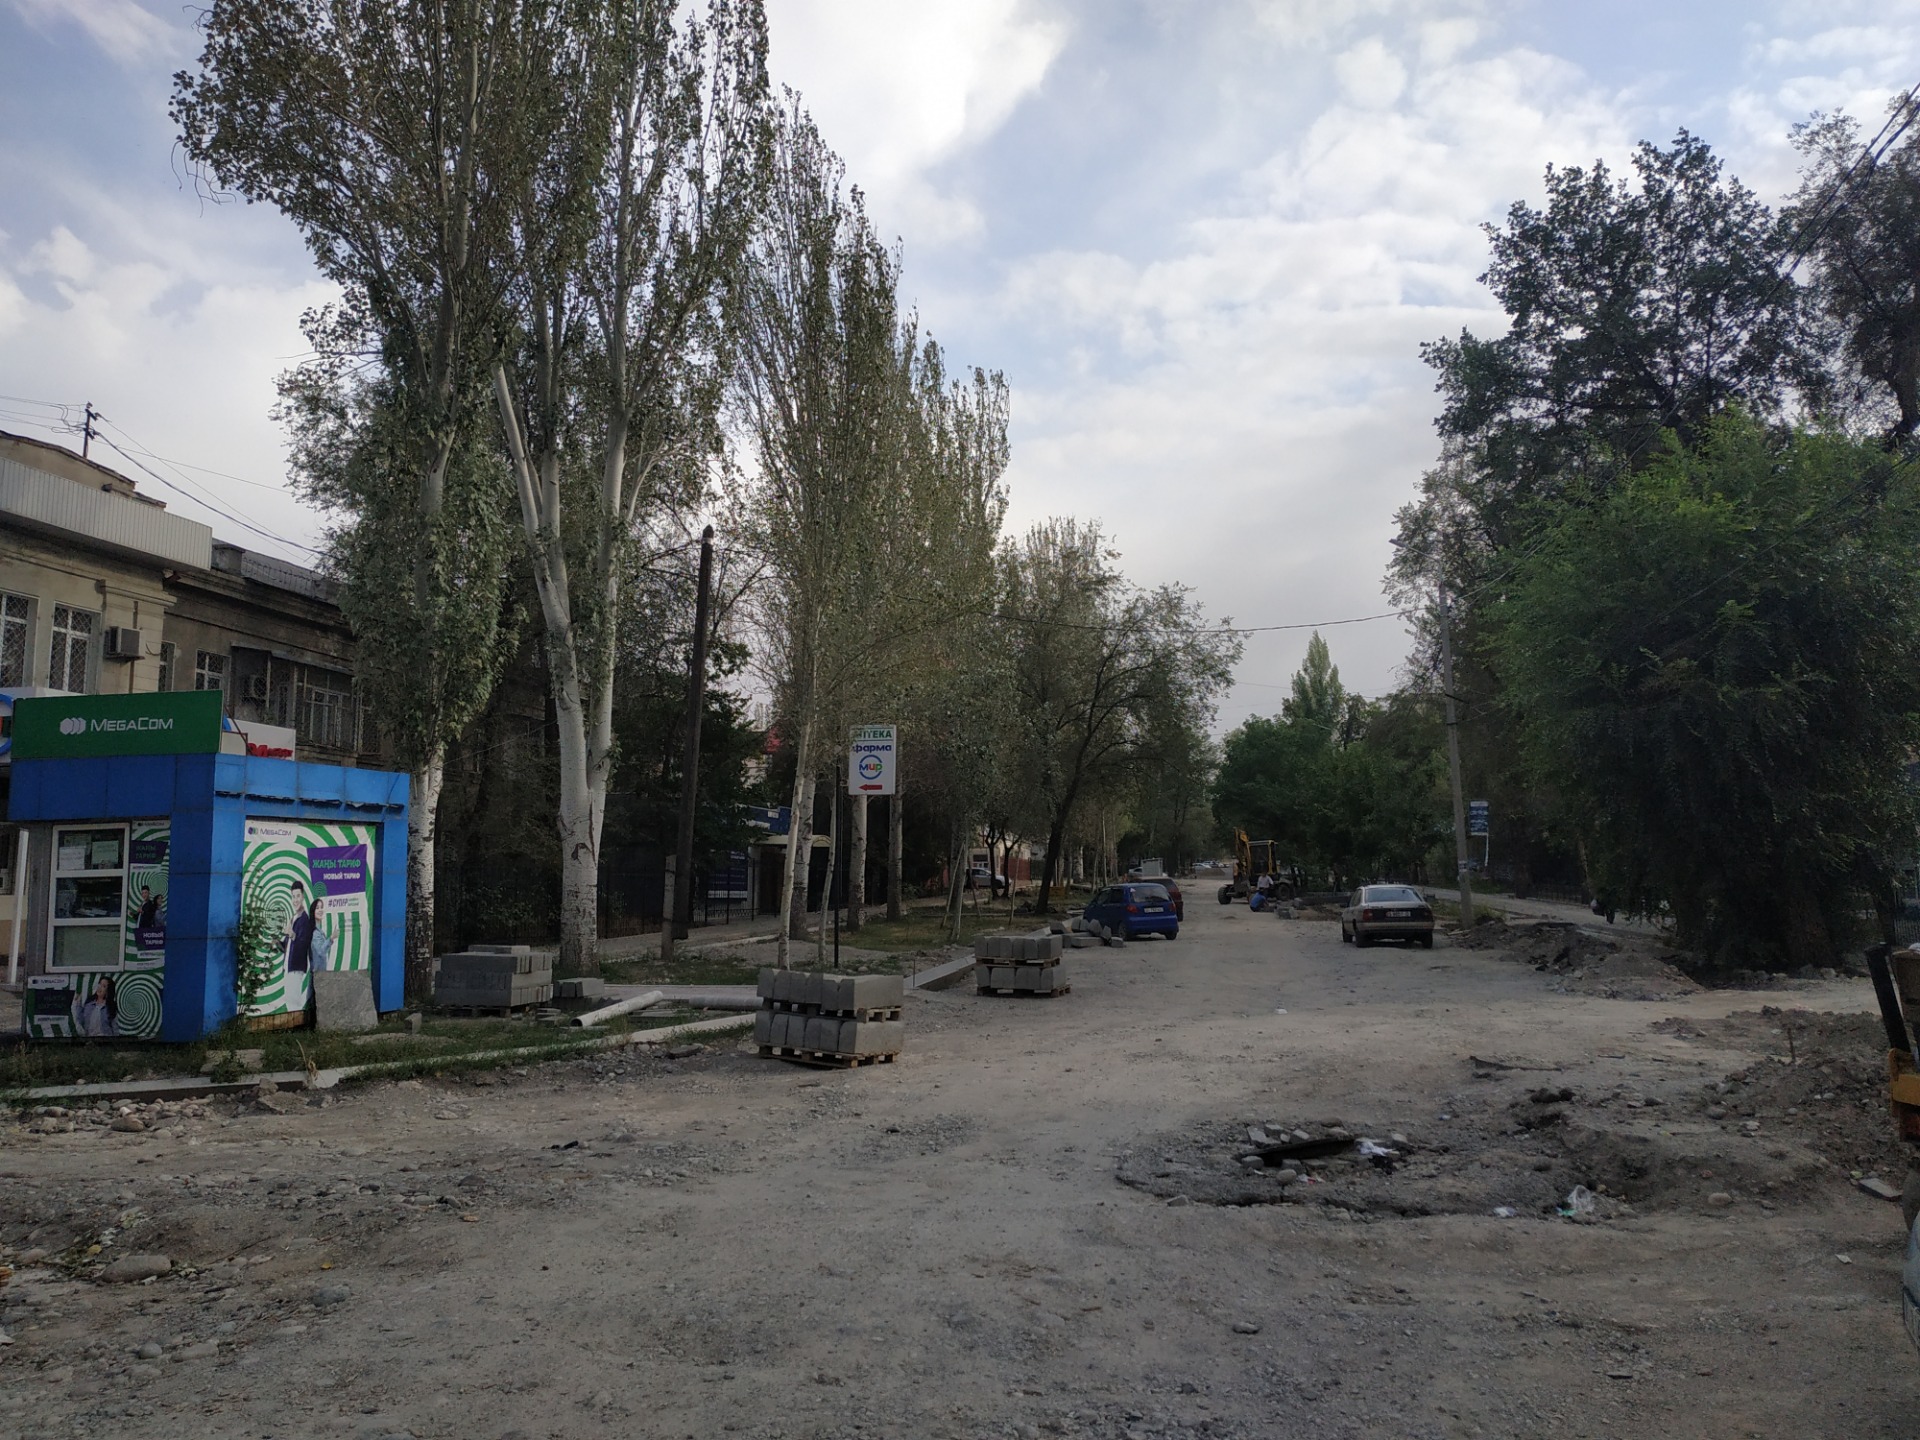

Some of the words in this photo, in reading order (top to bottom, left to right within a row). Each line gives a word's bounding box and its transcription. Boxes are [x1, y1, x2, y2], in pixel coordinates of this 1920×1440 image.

[338, 859, 361, 869] ТАРИФ
[323, 872, 343, 880] НОВЫЙ
[344, 872, 361, 880] ТАРИФ
